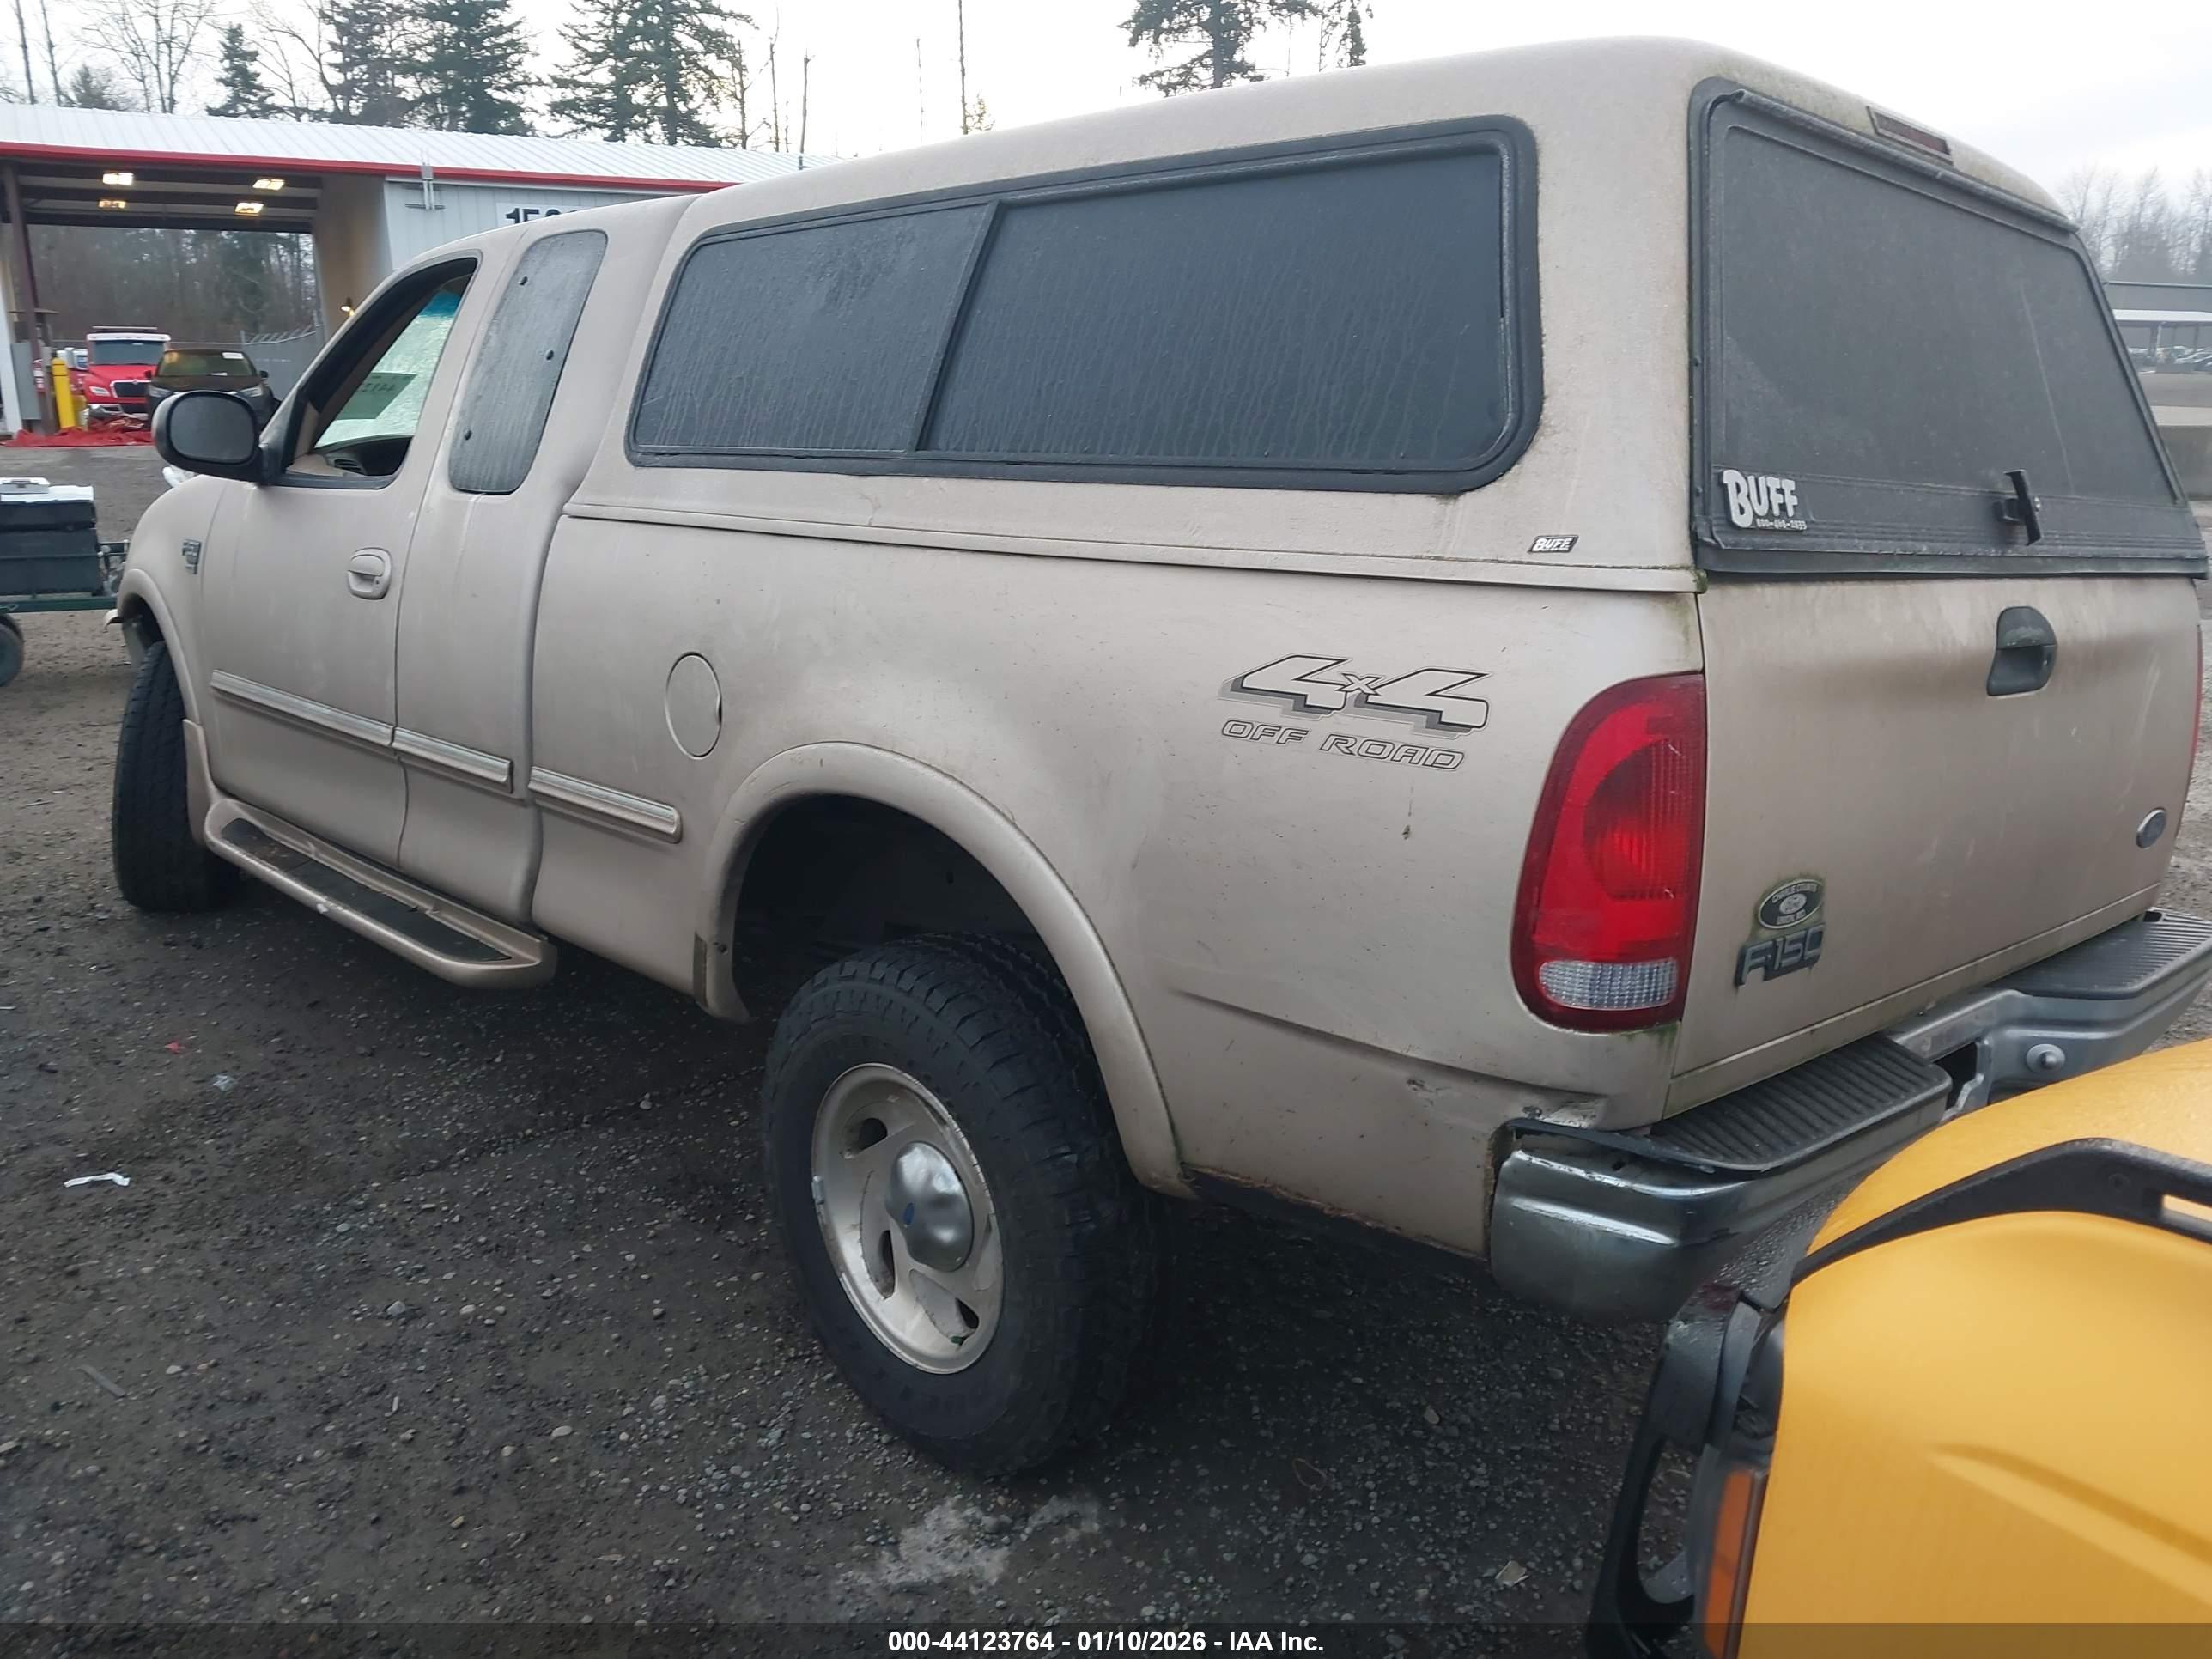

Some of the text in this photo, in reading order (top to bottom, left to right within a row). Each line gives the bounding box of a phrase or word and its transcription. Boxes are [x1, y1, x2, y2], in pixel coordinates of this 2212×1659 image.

[1723, 469, 1798, 528] BUFF
[1230, 653, 1491, 733] 4x4
[1221, 720, 1466, 771] OFF ROAD
